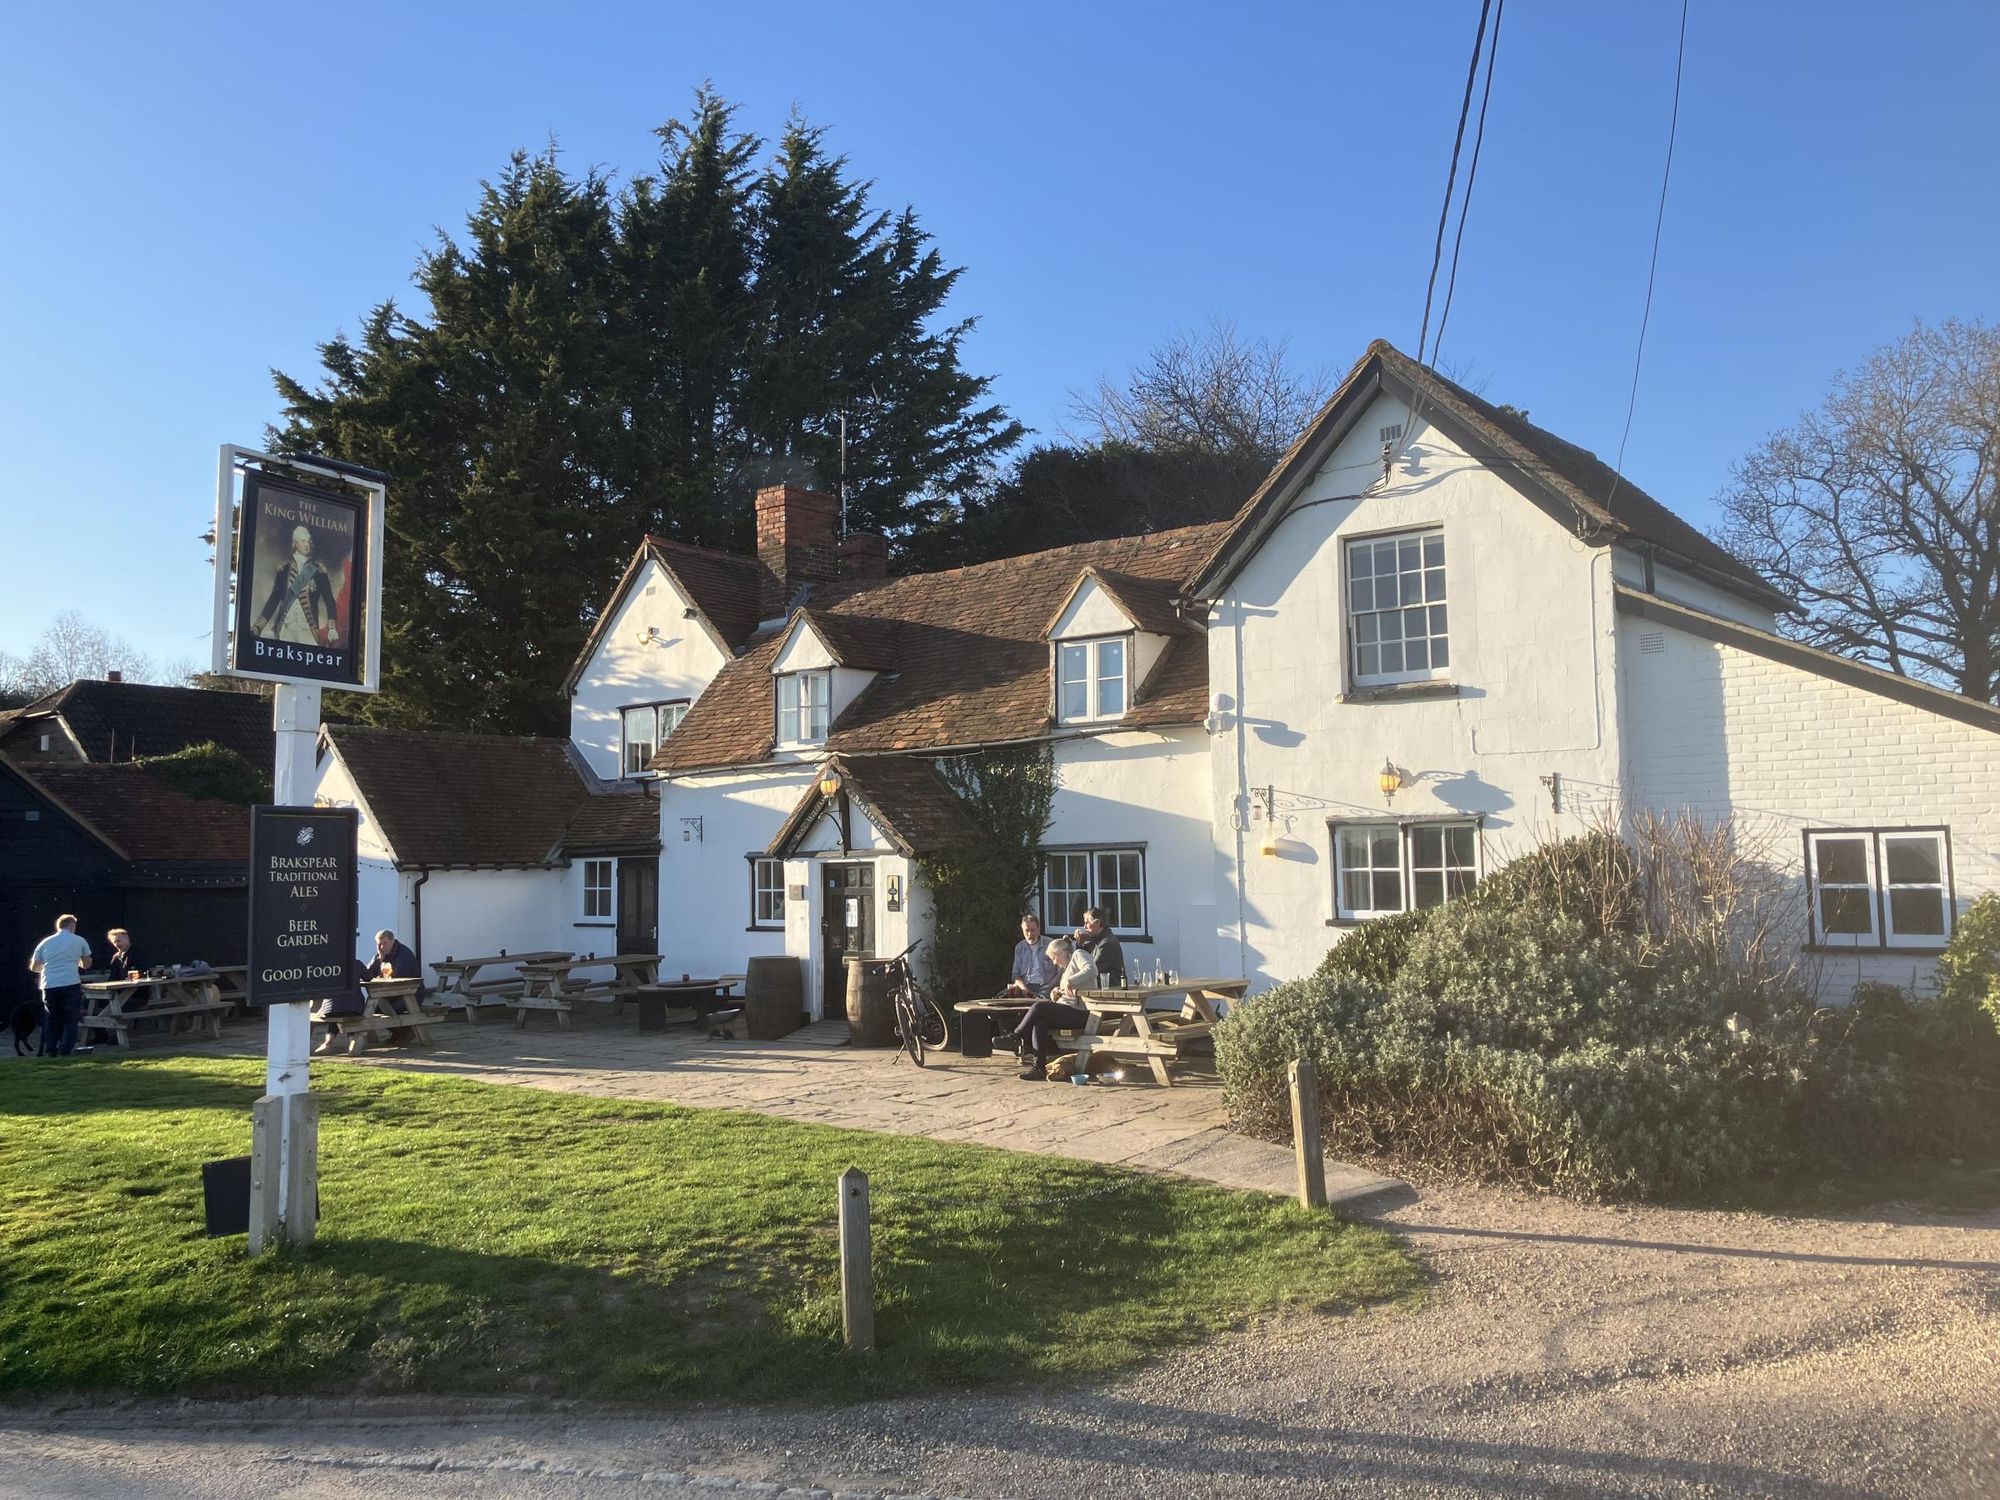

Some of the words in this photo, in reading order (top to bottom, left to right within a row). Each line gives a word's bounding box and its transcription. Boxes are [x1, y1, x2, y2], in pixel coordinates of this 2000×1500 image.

[298, 500, 317, 512] THE
[264, 502, 296, 521] KING
[298, 510, 348, 533] WILLIAM
[255, 640, 343, 667] Brakspear
[270, 855, 338, 869] BRAKSPEAR
[268, 870, 339, 882] TRADITIONAL
[289, 885, 318, 898] ALES
[288, 919, 318, 932] BEER
[277, 933, 329, 948] GARDEN
[262, 968, 302, 983] GOOD
[306, 965, 342, 979] FOOD
